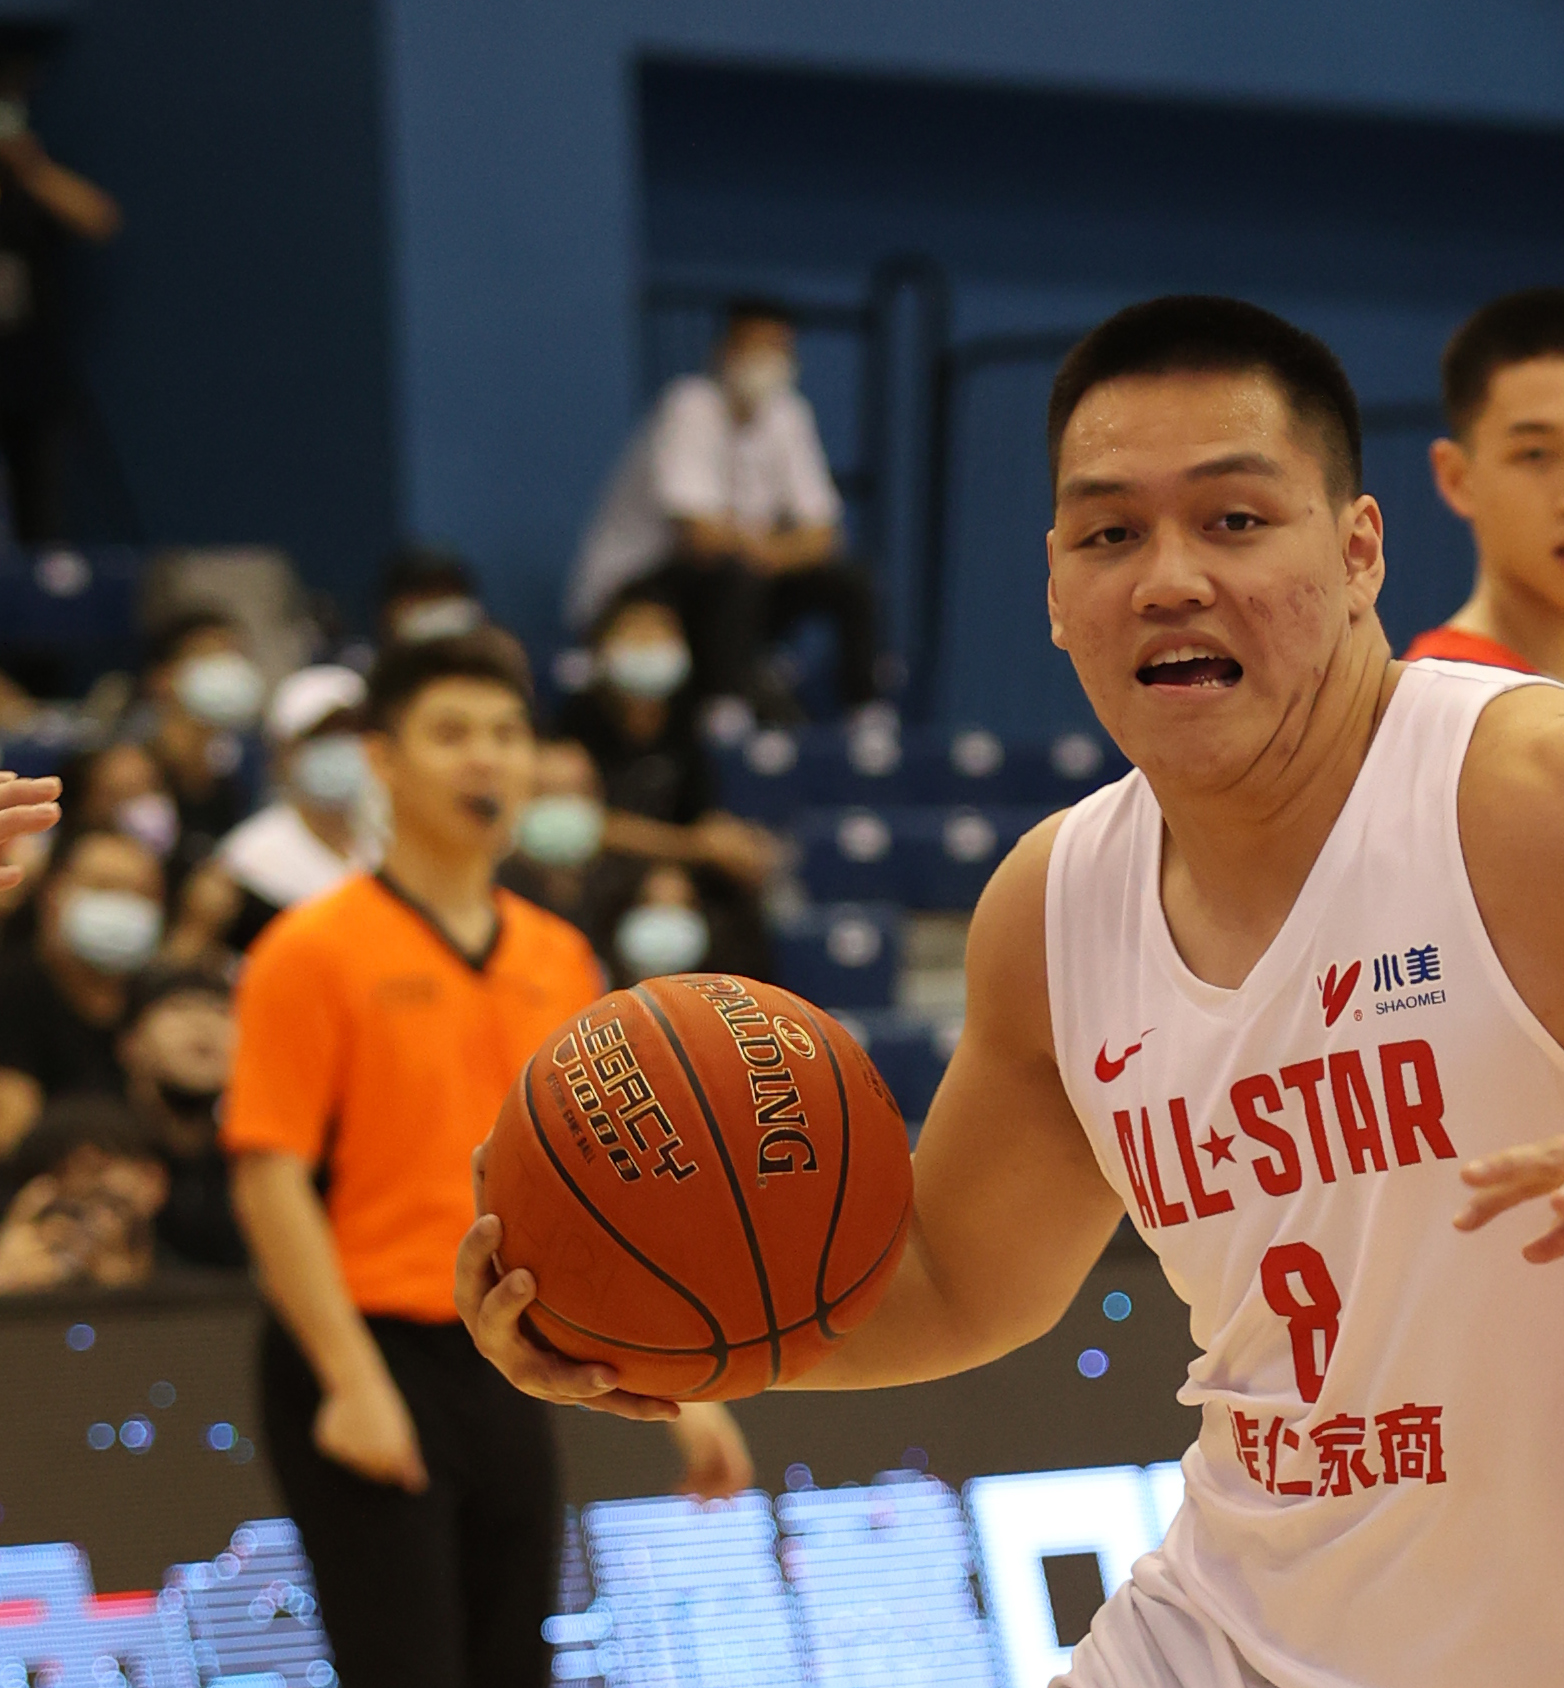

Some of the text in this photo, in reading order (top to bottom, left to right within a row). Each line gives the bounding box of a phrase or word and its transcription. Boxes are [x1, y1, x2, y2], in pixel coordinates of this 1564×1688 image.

[1373, 944, 1442, 993] 小美
[1375, 990, 1447, 1015] SHAOMEI
[564, 1062, 643, 1184] 1000
[672, 974, 820, 1176] PALDING
[1260, 1241, 1342, 1403] 8
